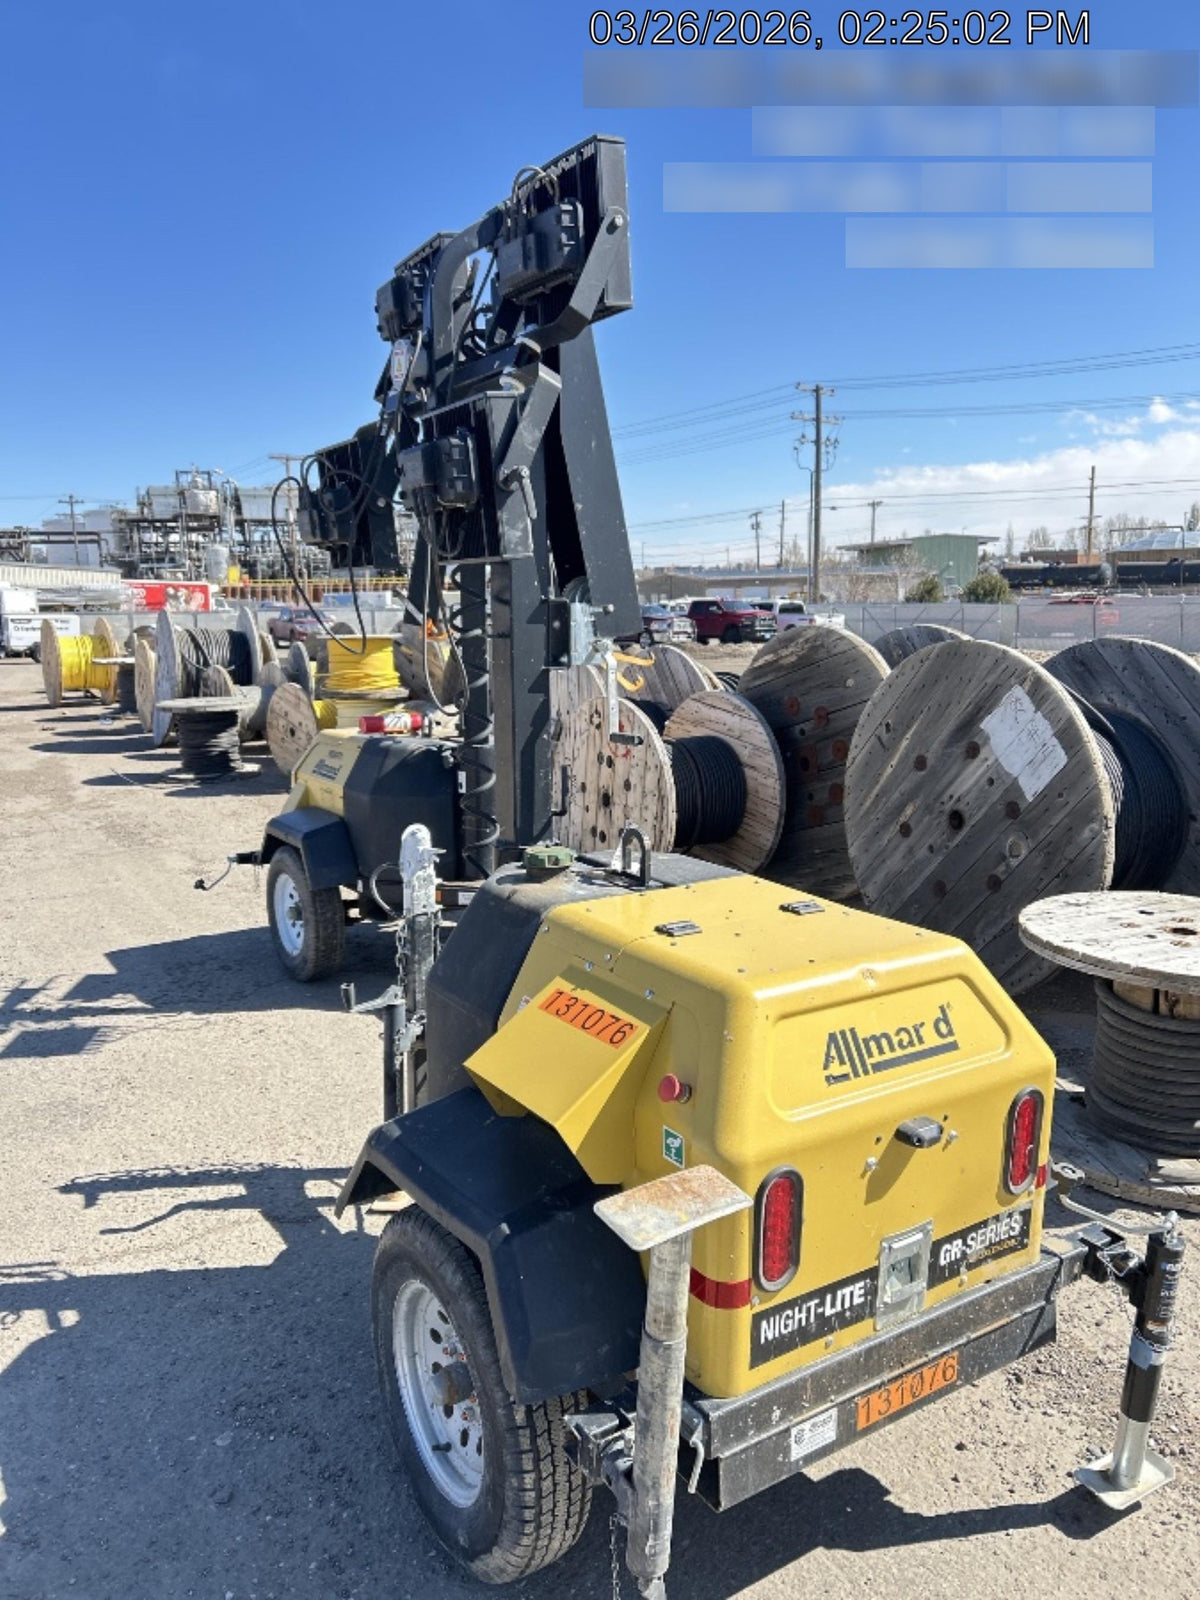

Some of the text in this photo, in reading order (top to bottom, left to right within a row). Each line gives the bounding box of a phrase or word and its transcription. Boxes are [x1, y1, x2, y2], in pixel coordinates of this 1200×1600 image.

[544, 990, 634, 1045] 131076
[940, 1215, 1023, 1267] GR-SERIES
[760, 1281, 866, 1345] NIGHT-LITE
[860, 1356, 957, 1425] 131076
